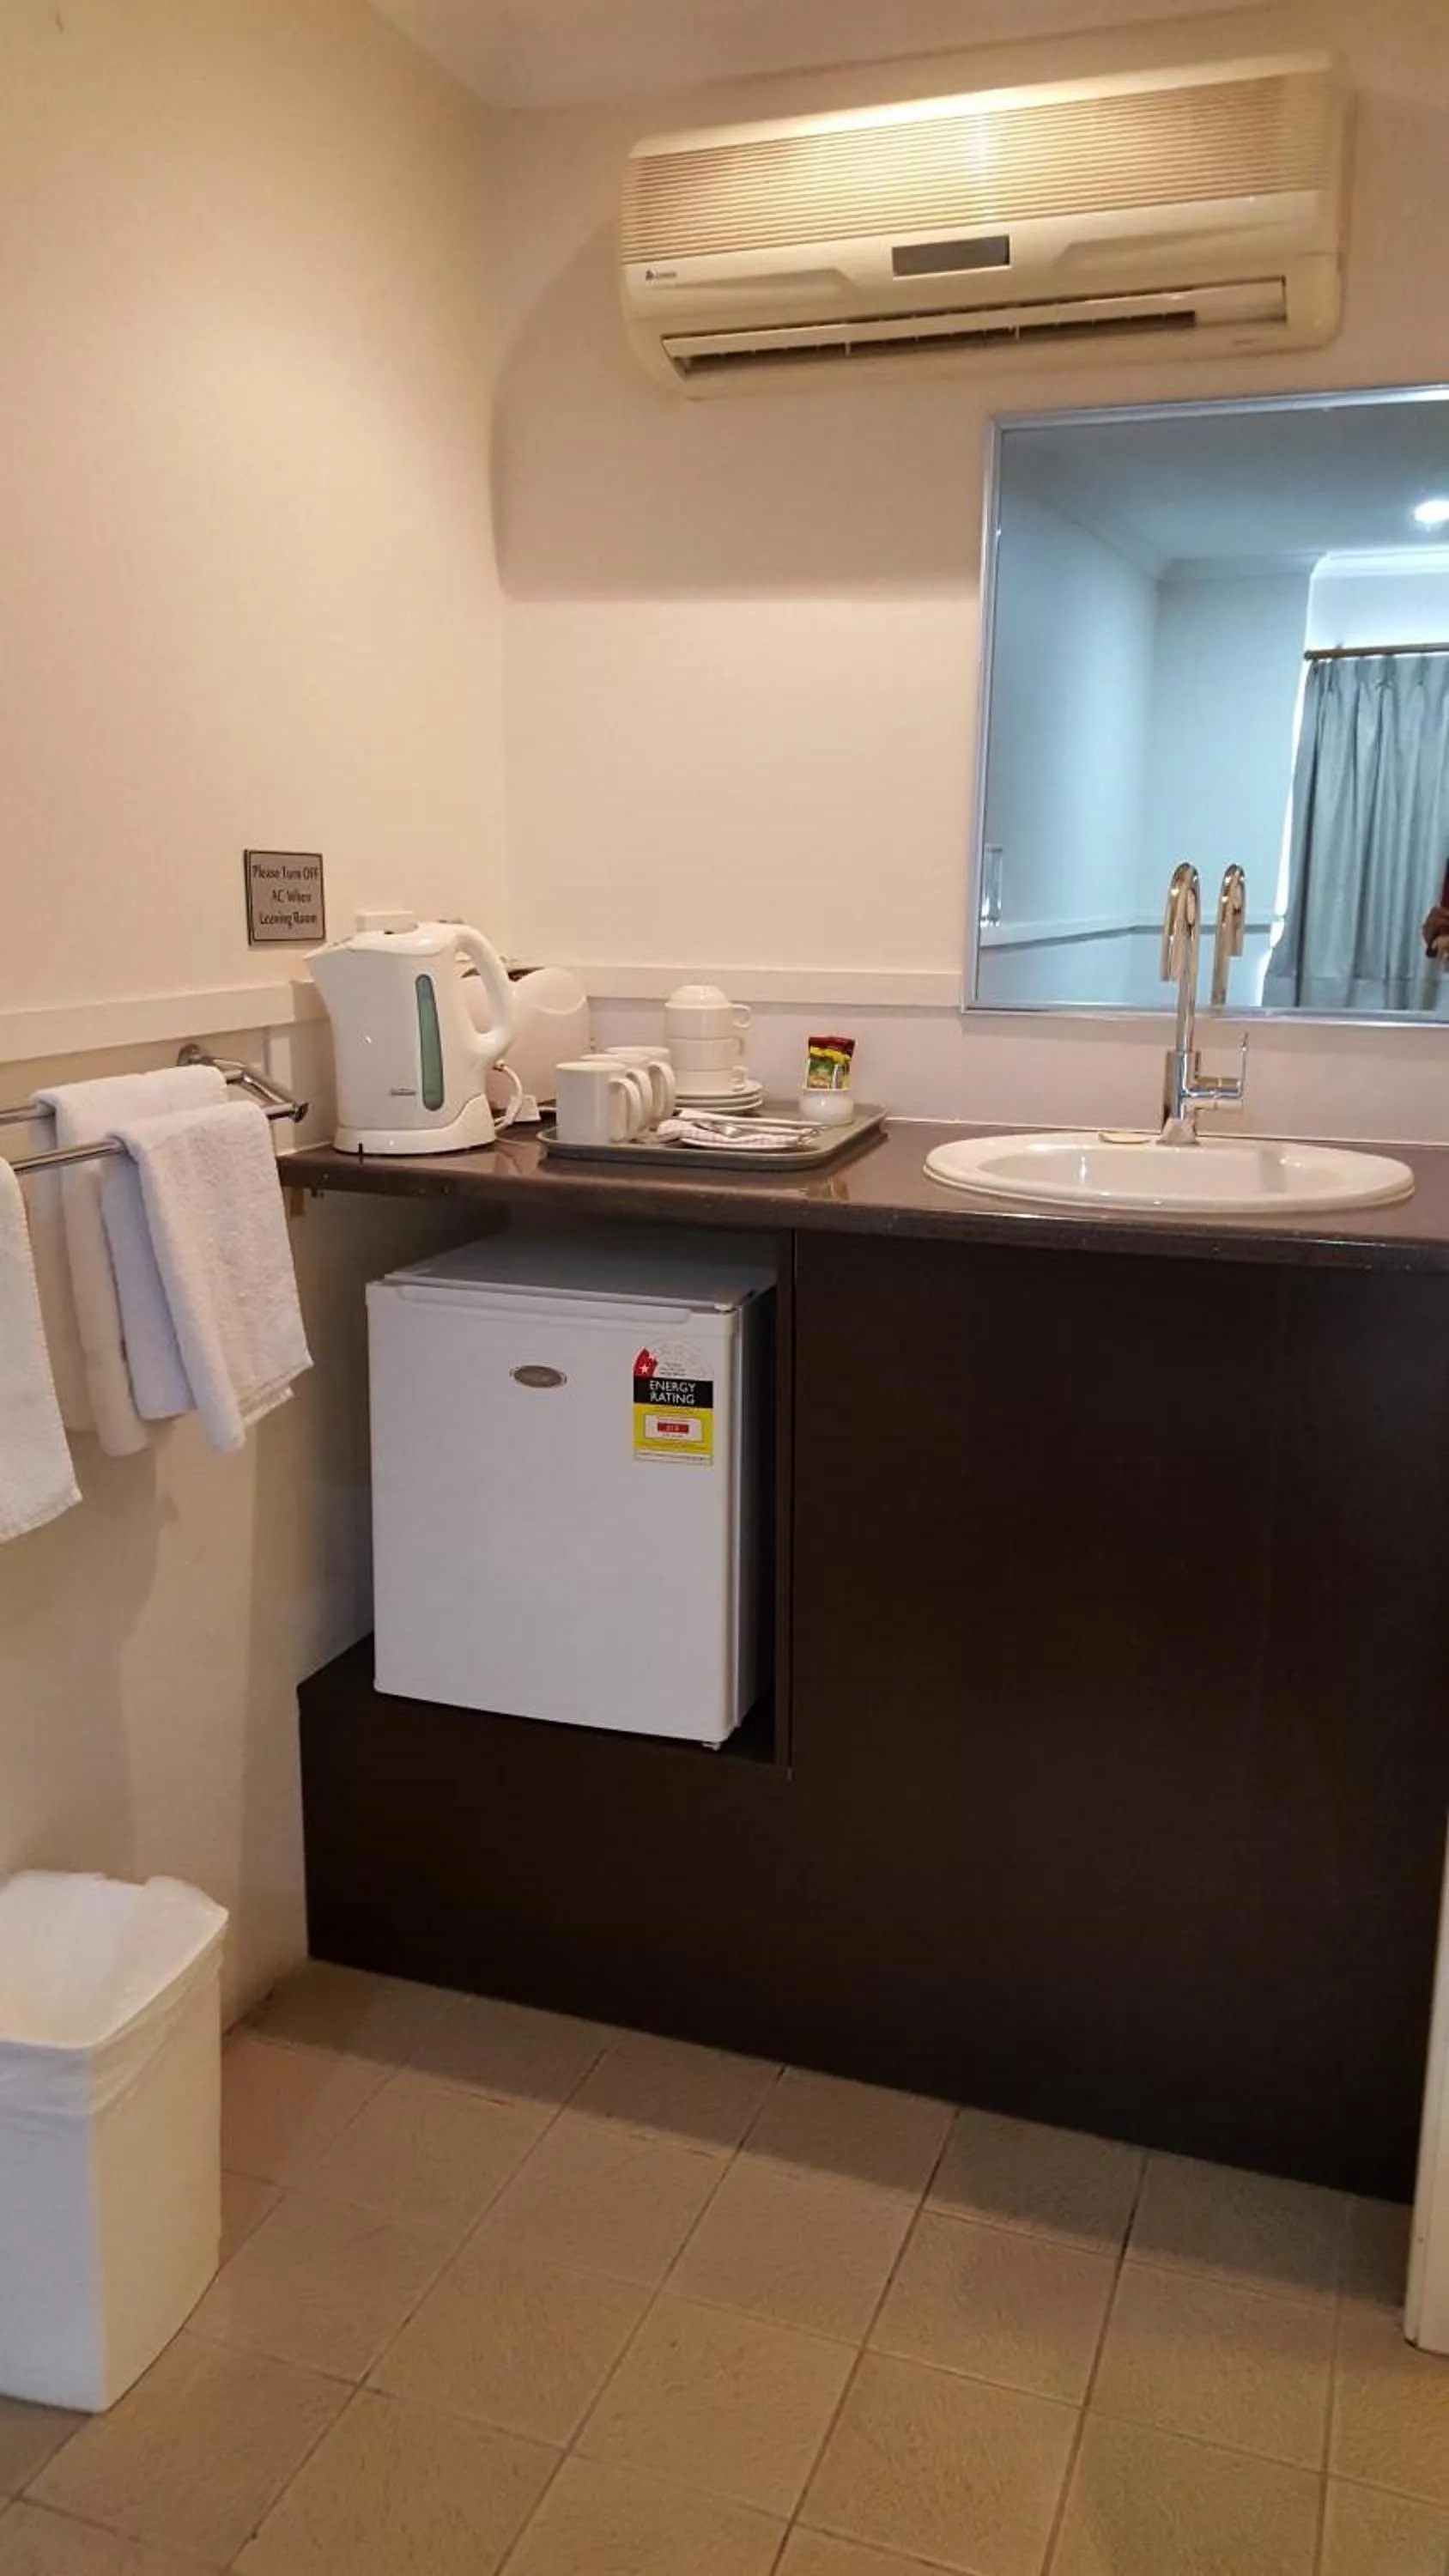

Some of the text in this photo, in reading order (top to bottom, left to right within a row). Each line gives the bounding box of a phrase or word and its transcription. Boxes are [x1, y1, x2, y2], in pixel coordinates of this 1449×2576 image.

[252, 865, 279, 878] Please
[281, 866, 301, 879] Turn
[271, 889, 312, 903] AC When
[260, 911, 317, 929] Leaving Room
[650, 1380, 696, 1393] ENERGY
[650, 1392, 694, 1405] RATING
